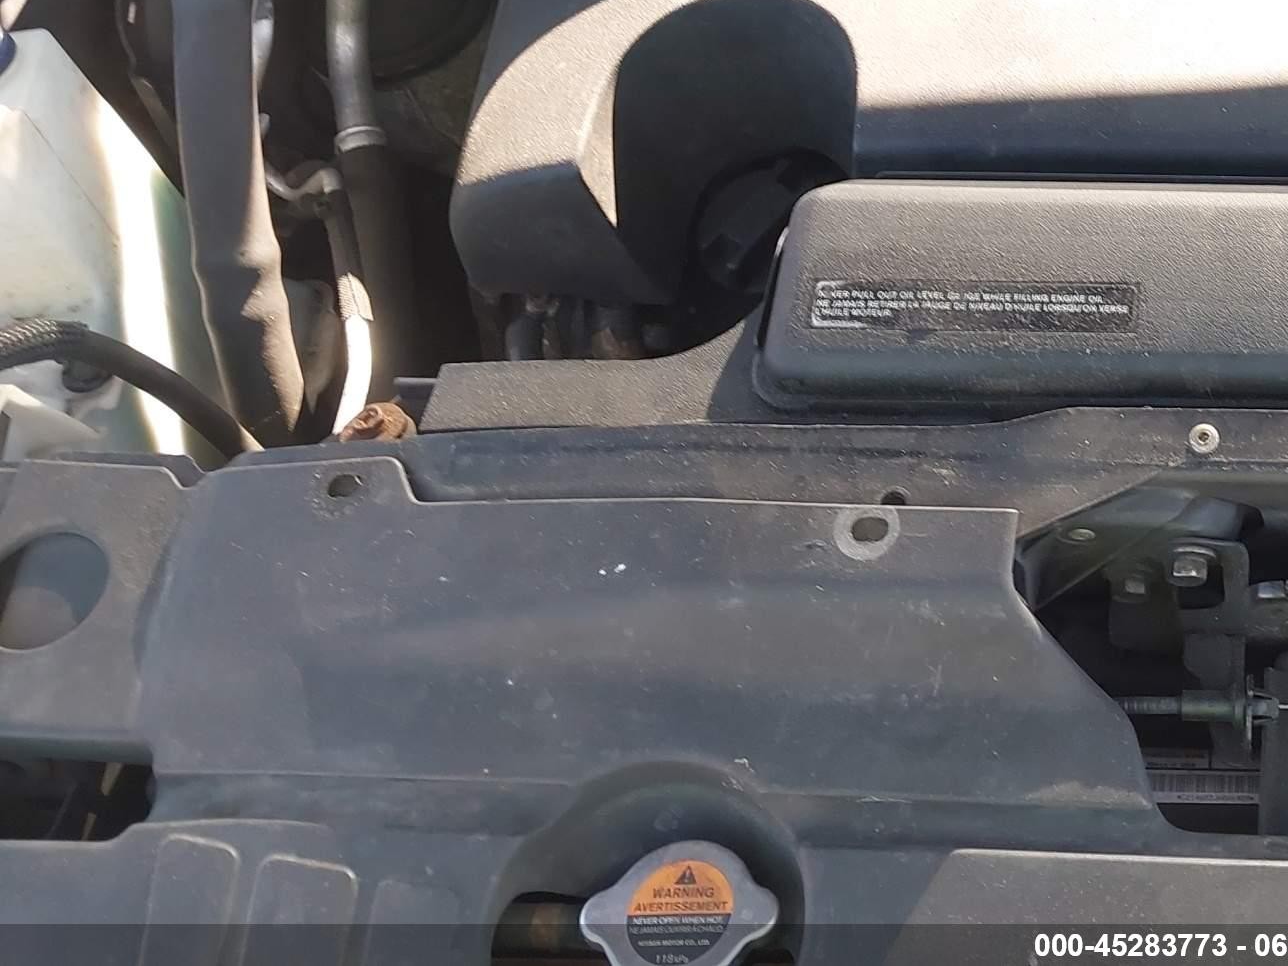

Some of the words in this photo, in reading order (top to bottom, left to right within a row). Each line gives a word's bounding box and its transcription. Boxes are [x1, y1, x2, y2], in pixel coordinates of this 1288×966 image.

[917, 291, 945, 301] LEVEL
[983, 292, 1011, 302] WHILE
[1013, 293, 1050, 303] FILLING
[1050, 294, 1086, 304] ENGINE
[816, 299, 831, 308] NE
[953, 302, 967, 311] DE
[968, 302, 1004, 312] NIVEAU
[653, 887, 714, 899] WARNING
[633, 901, 728, 912] AVERTISSEMENT
[632, 916, 658, 925] NEVER
[659, 916, 680, 924] OPEN
[681, 915, 705, 924] WHEN
